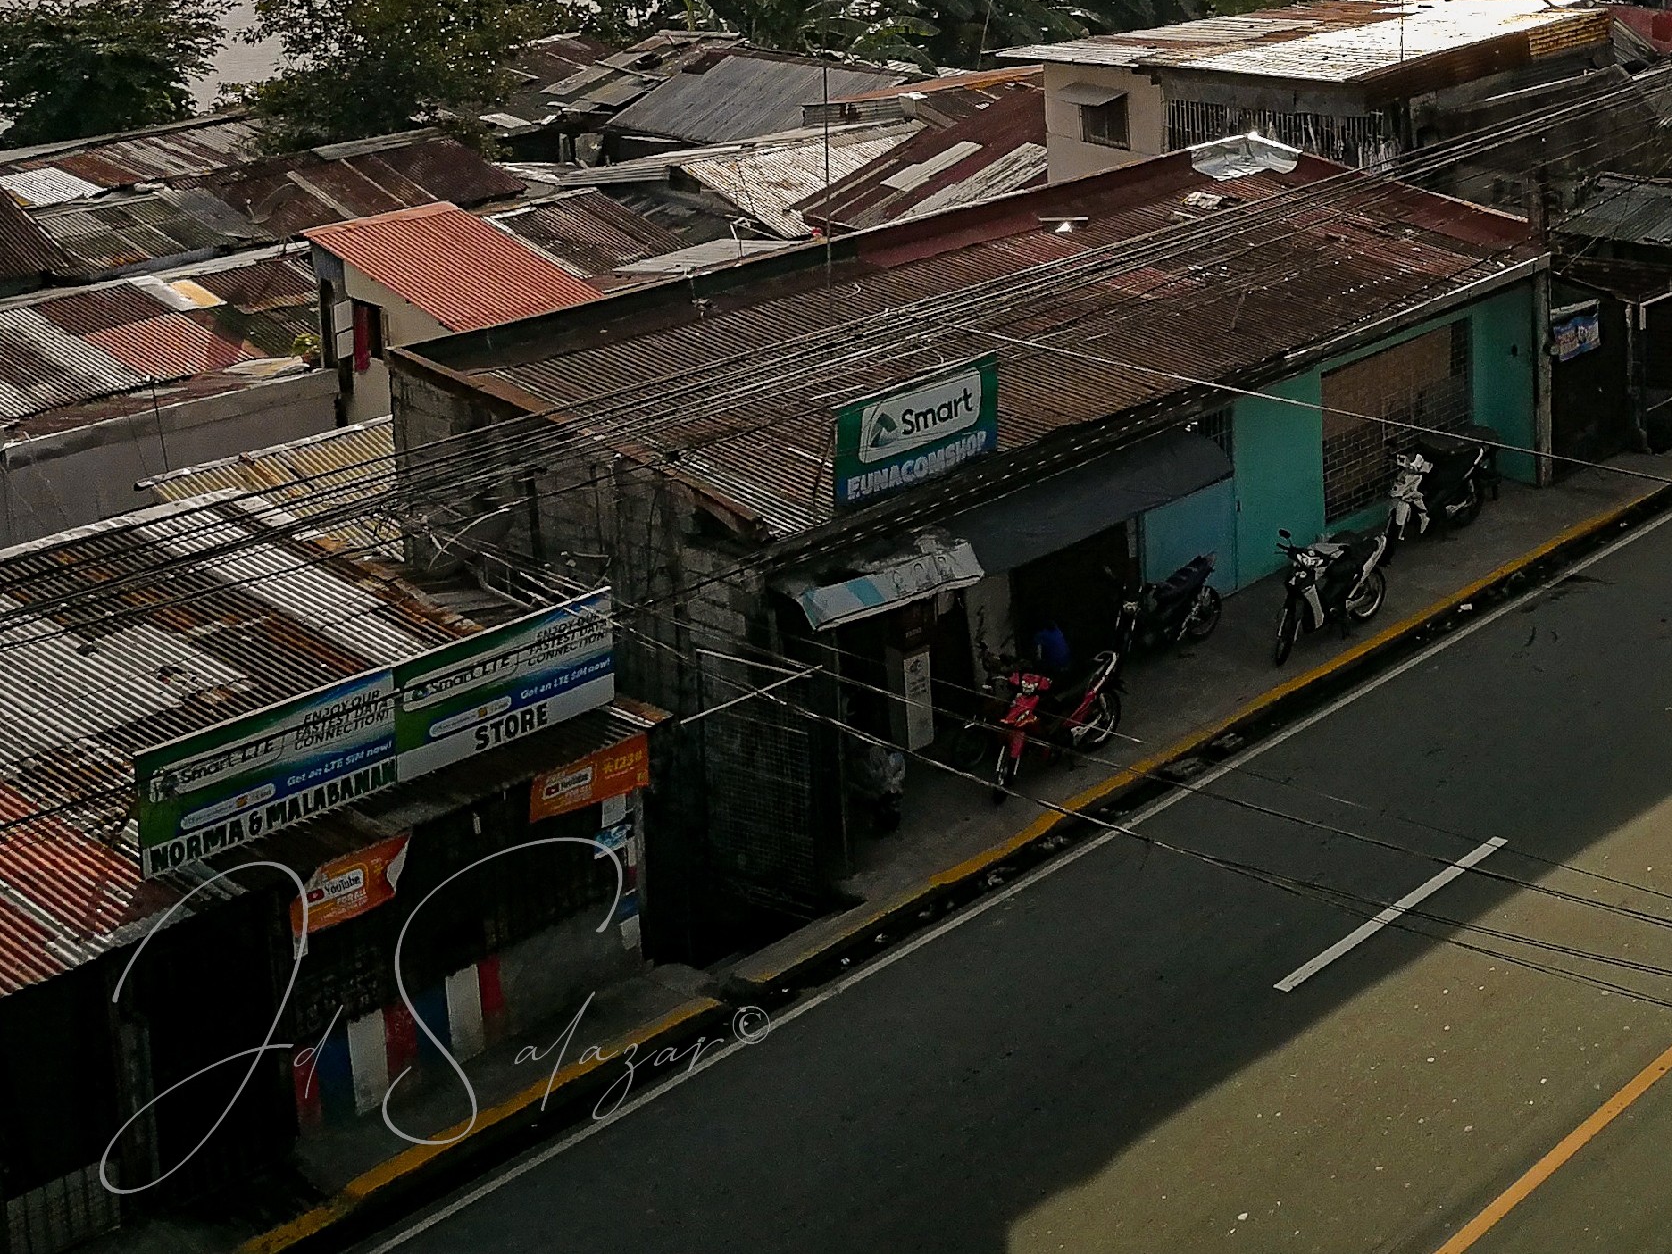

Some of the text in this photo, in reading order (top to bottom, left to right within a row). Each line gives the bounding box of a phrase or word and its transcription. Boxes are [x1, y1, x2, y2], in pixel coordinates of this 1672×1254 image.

[902, 388, 972, 435] Smart
[475, 703, 548, 752] STORE
[150, 820, 245, 873] NORMA
[324, 875, 360, 894] YouTube
